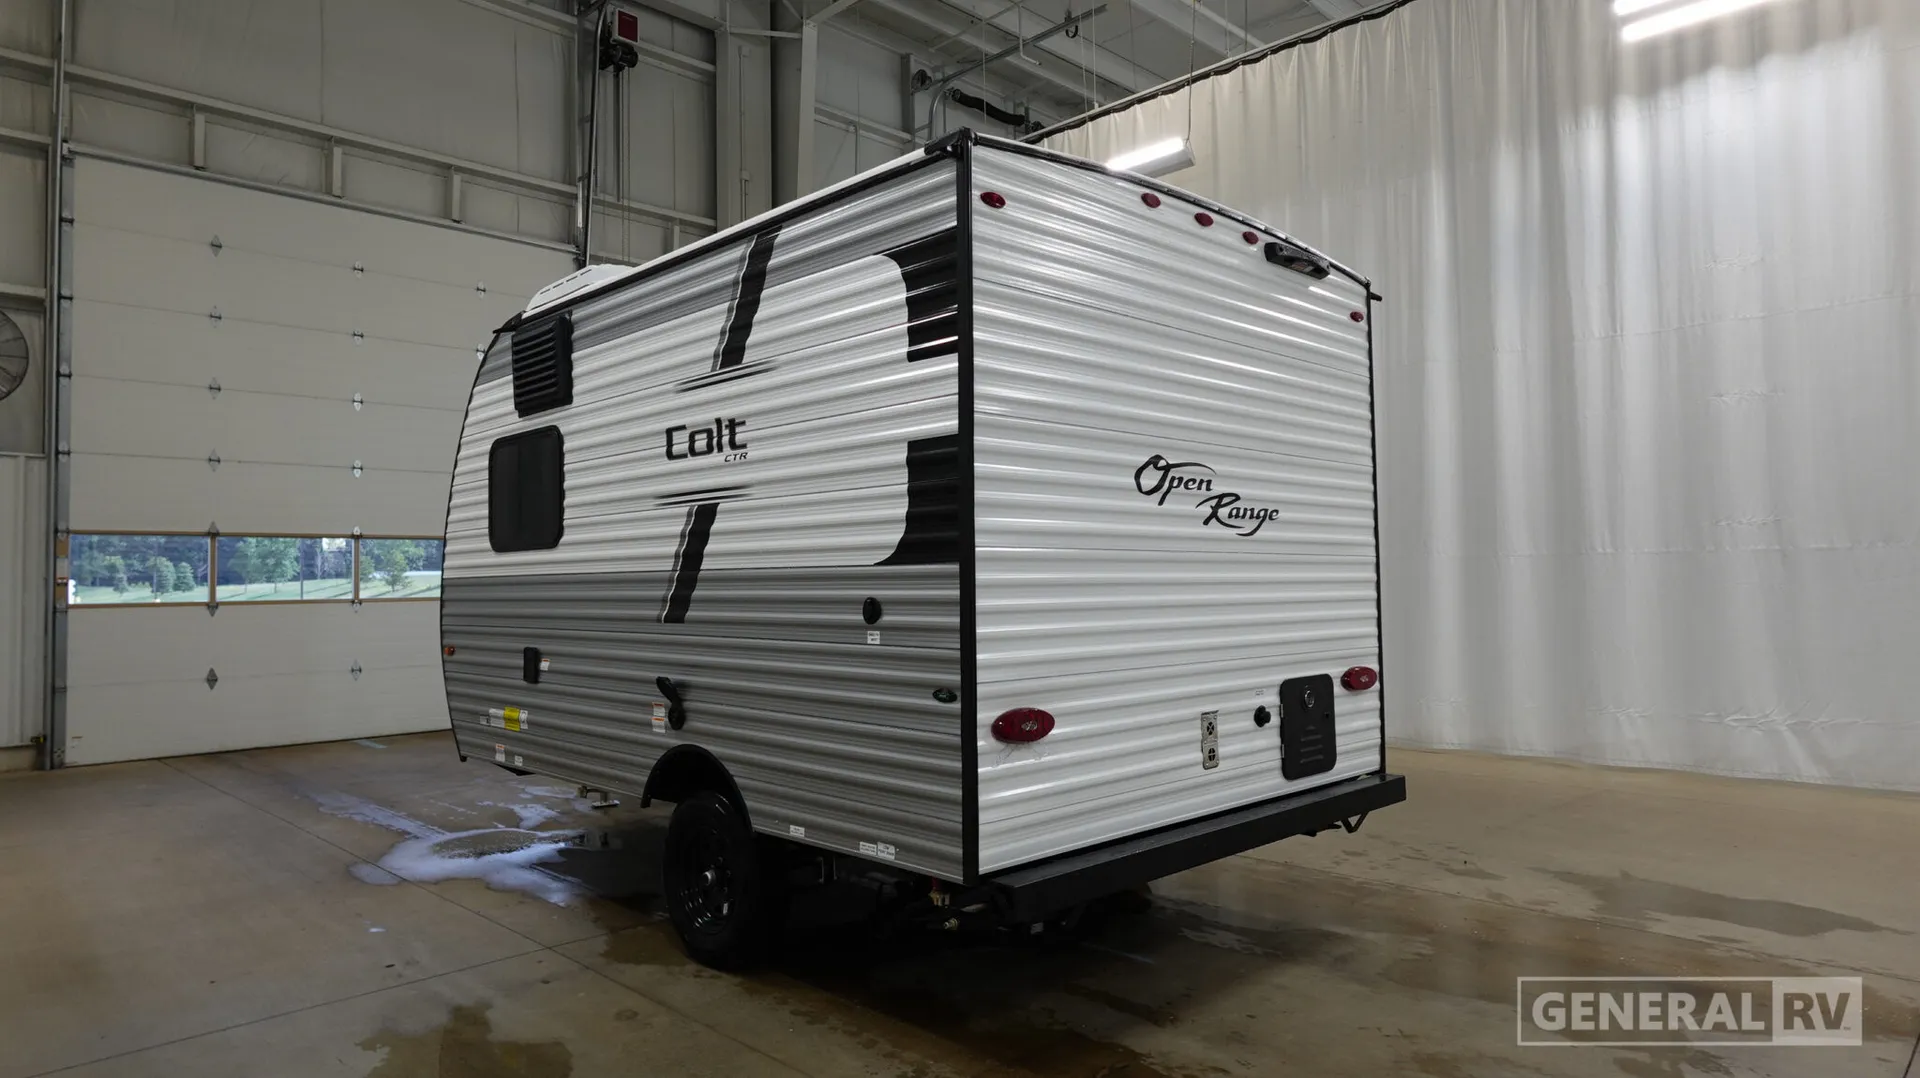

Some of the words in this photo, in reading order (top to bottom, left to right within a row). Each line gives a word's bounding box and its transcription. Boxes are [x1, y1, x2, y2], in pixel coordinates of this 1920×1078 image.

[665, 417, 747, 461] Colt
[724, 452, 748, 463] CTR
[1134, 454, 1217, 506] Open
[1195, 492, 1280, 537] Range
